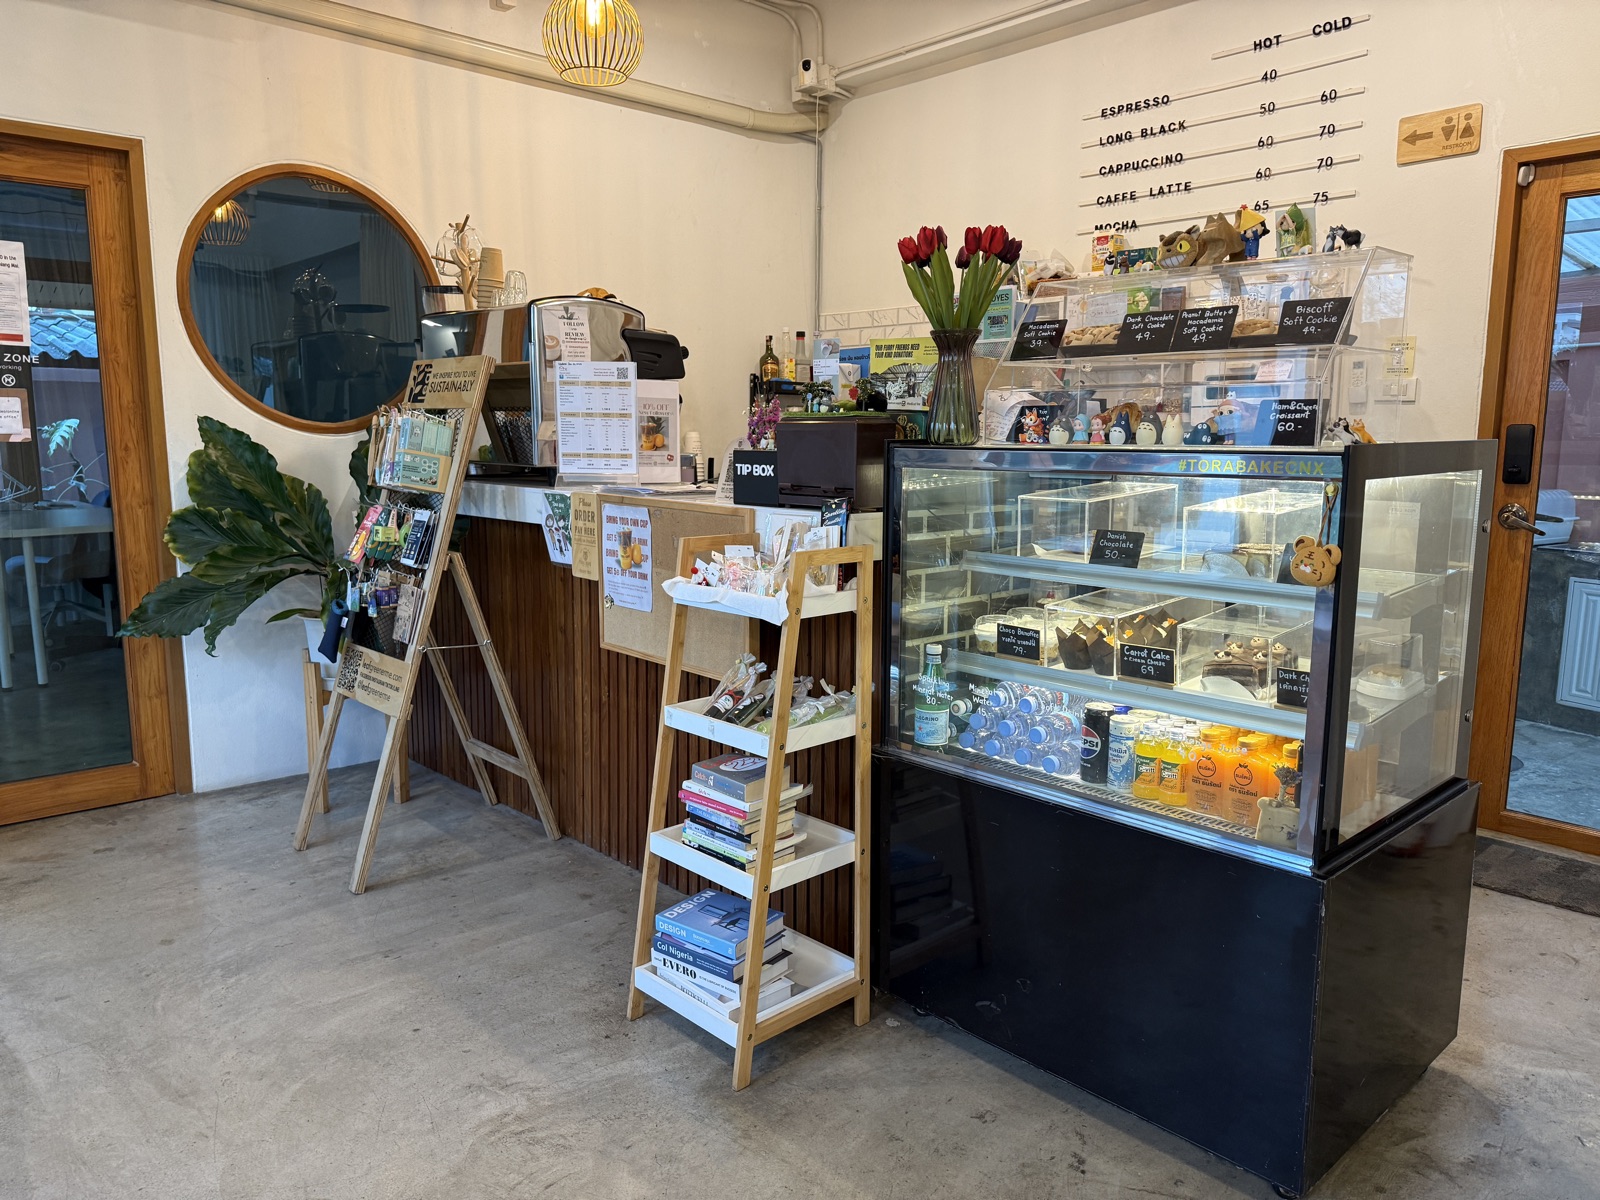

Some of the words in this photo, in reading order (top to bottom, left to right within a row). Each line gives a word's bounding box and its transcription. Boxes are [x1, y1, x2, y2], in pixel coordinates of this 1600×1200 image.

[1253, 35, 1282, 51] HOT
[1312, 17, 1352, 36] COLD
[1261, 69, 1277, 81] 40
[1101, 95, 1170, 118] ESPRESSO
[1099, 130, 1133, 146] LONG
[1140, 120, 1187, 138] BLACK
[1259, 102, 1276, 115] 50
[1320, 89, 1337, 102] 60
[1099, 152, 1184, 176] CAPPUCCINO
[1257, 136, 1274, 148] 60
[1319, 124, 1335, 137] 70
[1442, 141, 1472, 151] RESTROOM
[1096, 191, 1137, 206] CAFFE
[1149, 181, 1192, 197] LATTE
[1255, 168, 1271, 180] 60
[1317, 156, 1333, 169] 70
[1094, 220, 1138, 231] MOCHA
[1254, 200, 1270, 212] 65
[1313, 191, 1329, 204] 75
[1296, 301, 1334, 314] Biscoff
[1145, 314, 1175, 322] Chocolate
[1187, 317, 1224, 325] Macadamia
[1283, 316, 1304, 326] Soft
[1306, 315, 1338, 324] Cookie
[1182, 327, 1198, 335] Soft
[1201, 325, 1223, 333] Cookie
[3, 353, 40, 364] ZONE
[428, 380, 476, 393] SUSTAINABLY
[656, 403, 670, 411] OFF
[1269, 410, 1311, 420] Croissant
[735, 463, 752, 476] TIP
[752, 464, 775, 477] BOX
[1178, 459, 1325, 476] #TORABAKECNX
[574, 509, 596, 524] ORDER
[606, 514, 618, 525] BRING
[618, 516, 630, 527] YOUR
[640, 519, 648, 529] CUP
[574, 525, 583, 535] PAY
[584, 527, 596, 537] HERE
[1107, 531, 1127, 540] Danish
[1099, 539, 1134, 549] Chocolate
[999, 625, 1016, 635] Choco
[1123, 645, 1149, 658] Carrot
[1150, 650, 1171, 661] Cake
[1278, 670, 1298, 680] Dark
[1219, 743, 1248, 756] Juice
[663, 890, 717, 919] DESIGN
[659, 921, 687, 938] DESIGN
[656, 941, 668, 951] Col
[669, 945, 694, 962] Nigeria
[662, 957, 697, 980] EVERO
